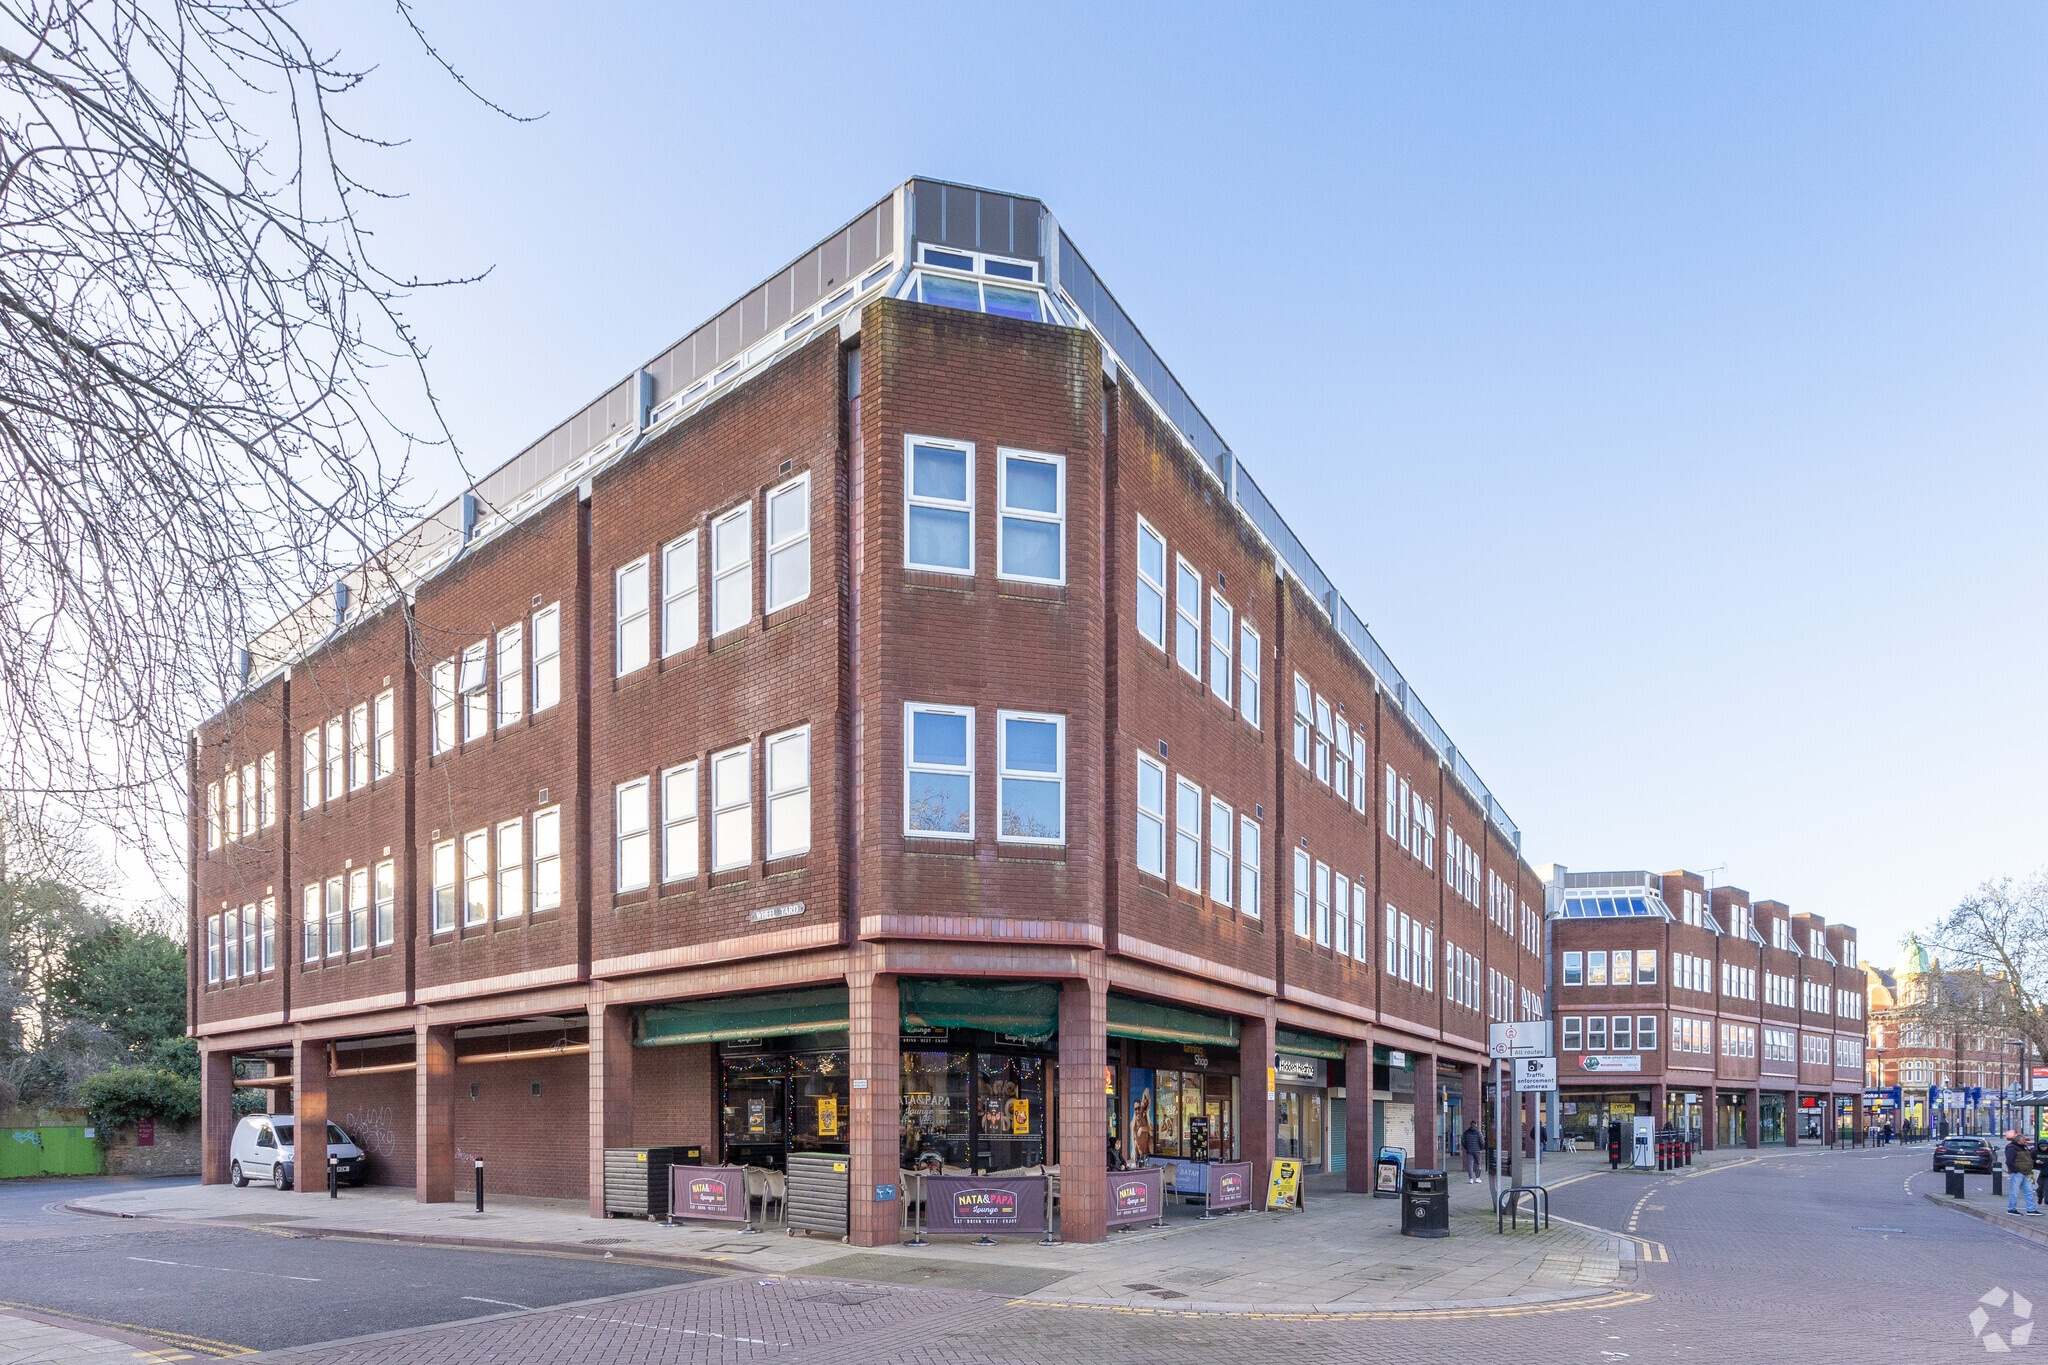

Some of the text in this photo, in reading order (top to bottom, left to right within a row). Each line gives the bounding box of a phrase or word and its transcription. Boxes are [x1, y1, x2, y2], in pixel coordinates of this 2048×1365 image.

[780, 905, 799, 915] YARD
[1194, 1055, 1208, 1069] Shop
[899, 1094, 951, 1106] ATA&PAPA
[958, 1194, 1013, 1205] NATA&PAPA
[972, 1205, 999, 1215] Lounge
